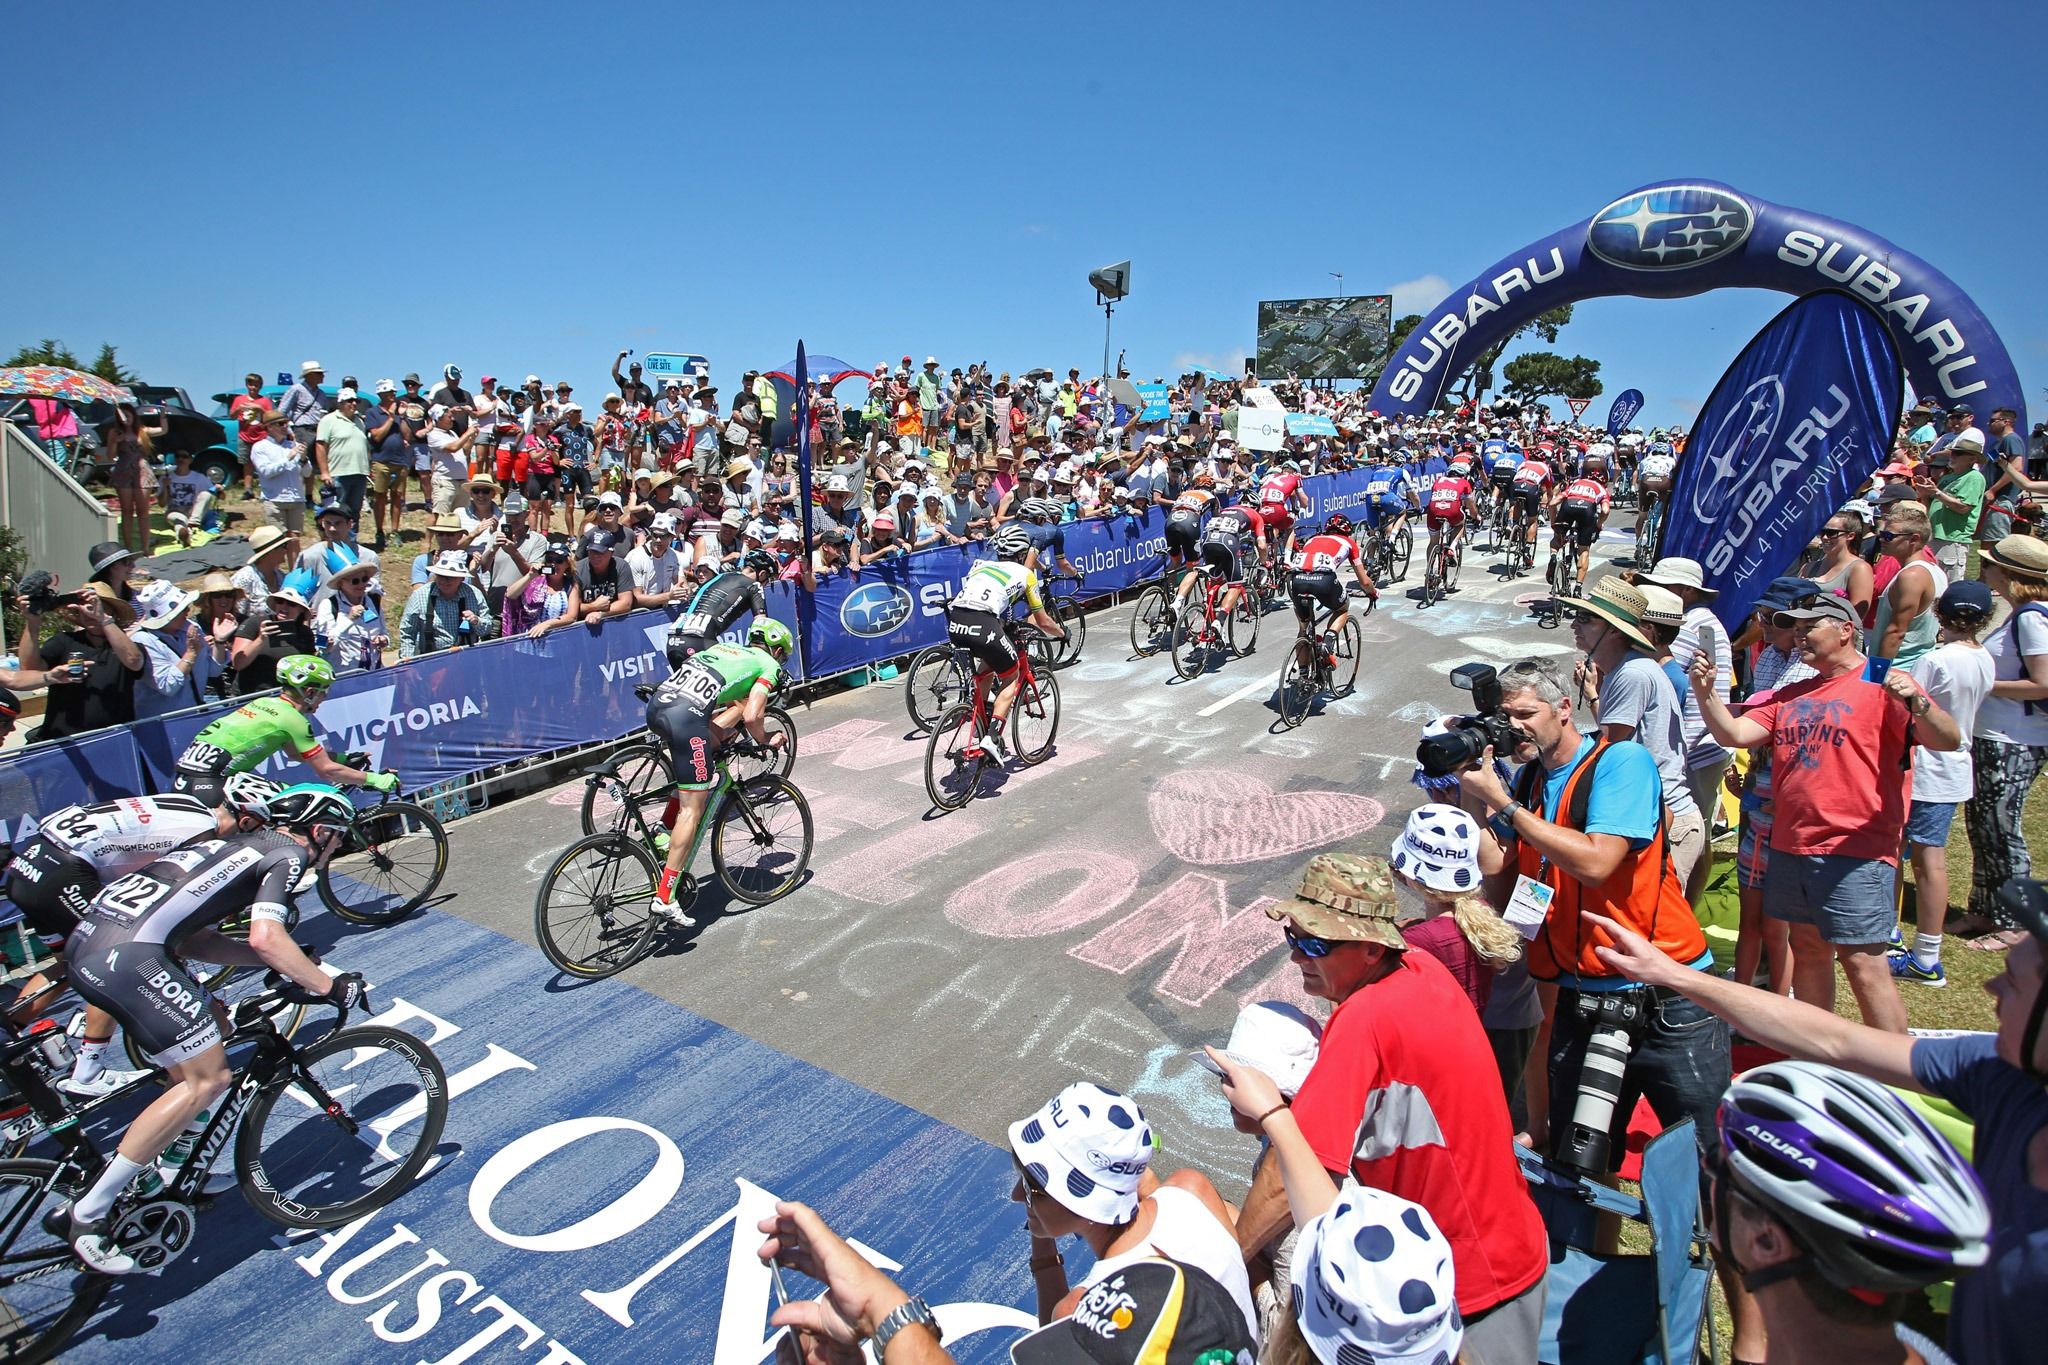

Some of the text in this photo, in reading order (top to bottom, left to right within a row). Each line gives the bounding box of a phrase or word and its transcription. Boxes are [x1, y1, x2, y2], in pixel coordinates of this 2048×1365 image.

[1389, 247, 1565, 402] SUBARU
[1777, 230, 1987, 398] SUBARU
[648, 362, 659, 370] LIVE
[1617, 400, 1637, 430] SUBARU
[1271, 490, 1282, 499] 63
[1412, 472, 1446, 494] SUBA
[1705, 383, 1851, 577] SUBARU
[1323, 490, 1368, 513] subaru.com
[1225, 518, 1237, 528] 92
[1075, 534, 1168, 577] subaru.com
[1732, 555, 1763, 588] ALL
[1758, 537, 1772, 553] 4
[1766, 500, 1803, 538] THE
[980, 588, 992, 602] 5
[1005, 581, 1023, 597] BMC
[948, 620, 982, 636] BMC
[999, 635, 1018, 661] BMC
[598, 651, 657, 683] VISIT
[687, 673, 717, 701] 106
[323, 695, 482, 754] VICTORIA
[689, 736, 709, 784] drapac
[609, 786, 621, 804] 106
[56, 812, 99, 841] 84
[93, 840, 174, 857] #CREATINGMEMORIES
[1407, 833, 1468, 860] SUBARU
[185, 854, 250, 899] hansgrohe
[285, 857, 301, 893] BORA
[80, 967, 101, 988] CRAFT
[702, 884, 1165, 1092] RICHIE
[136, 983, 190, 1029] cooking systems
[147, 969, 204, 1020] BORA
[174, 1016, 209, 1042] CRAFT
[13, 1117, 37, 1137] 22
[180, 1072, 258, 1198] S-WORKS
[1745, 1123, 1818, 1171] ADURA
